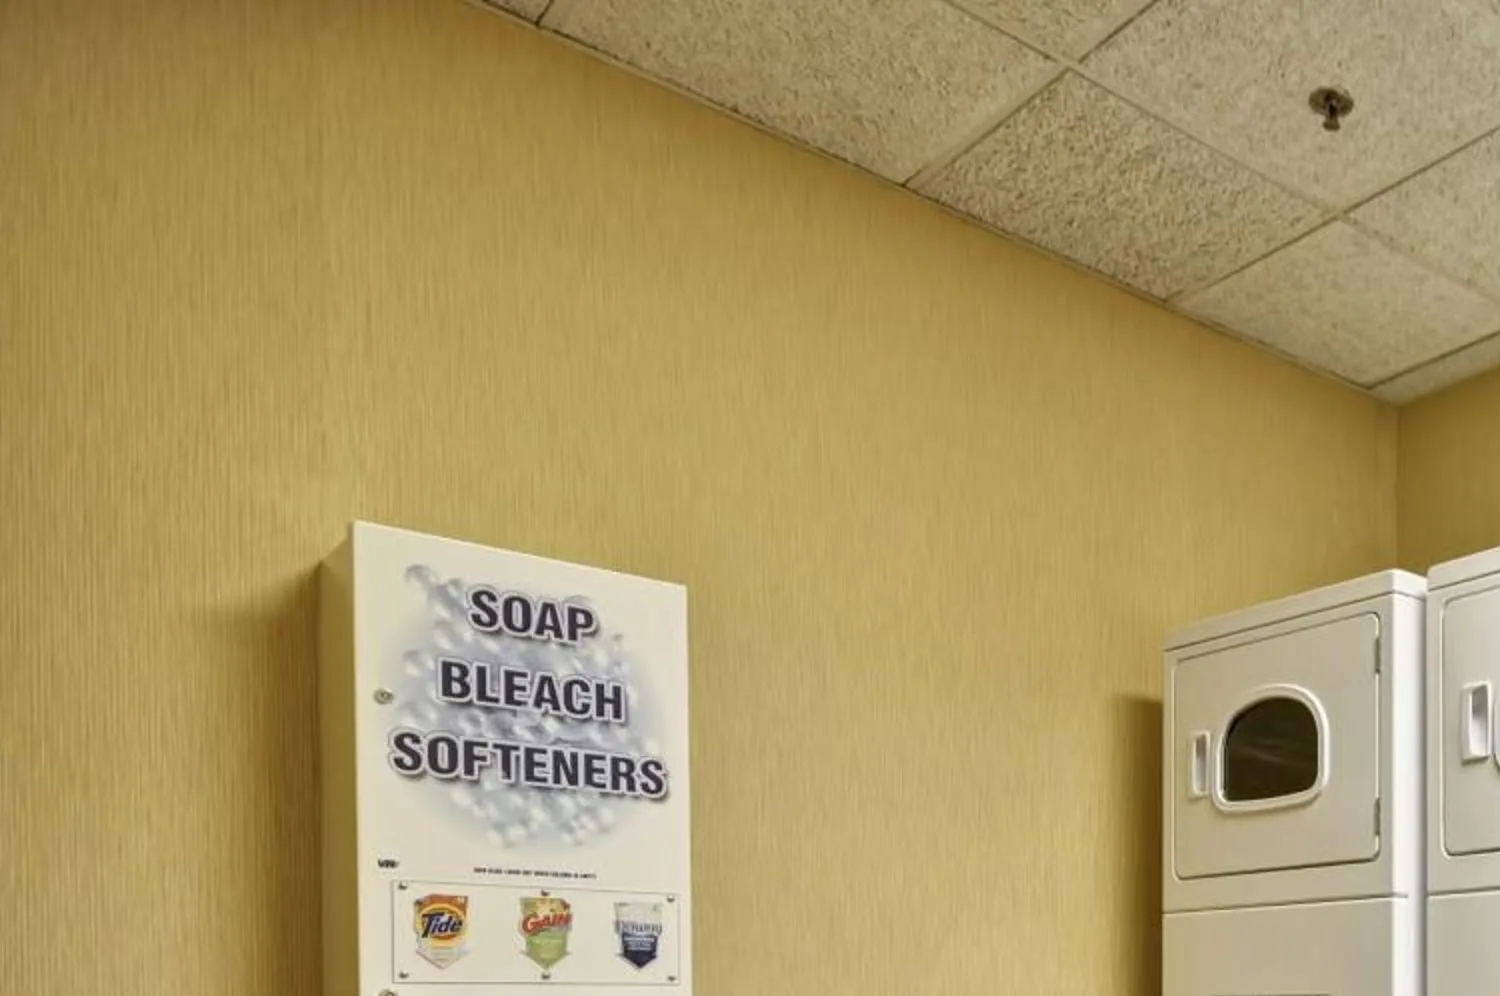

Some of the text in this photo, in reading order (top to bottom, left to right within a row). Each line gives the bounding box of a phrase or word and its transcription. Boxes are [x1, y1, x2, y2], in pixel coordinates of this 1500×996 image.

[469, 587, 597, 644] SOAP
[438, 658, 625, 722] BLEACH
[390, 730, 668, 798] SOFTENERS
[421, 911, 464, 939] Tide
